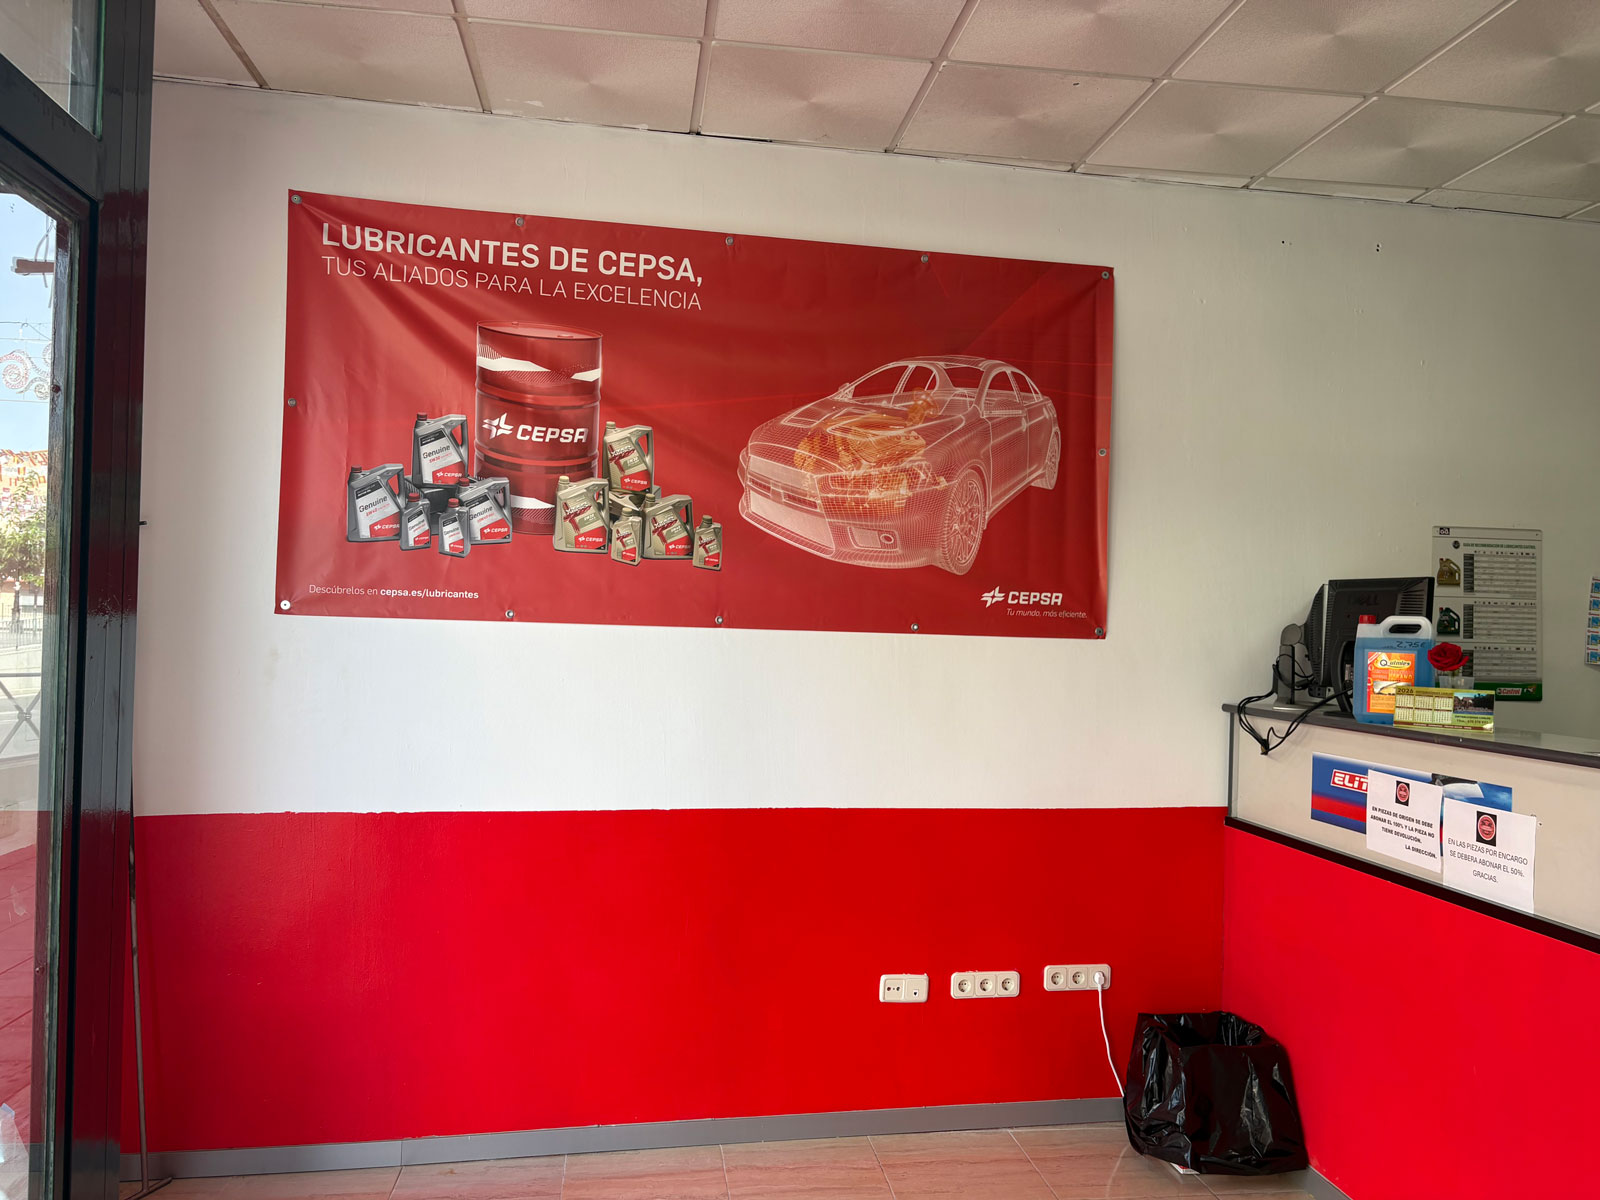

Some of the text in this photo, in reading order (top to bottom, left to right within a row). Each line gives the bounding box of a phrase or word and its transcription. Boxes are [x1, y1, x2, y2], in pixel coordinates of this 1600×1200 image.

[322, 222, 703, 287] LUBRICANTES DE CEPSA,
[321, 254, 702, 311] TUS ALIADOS PARA LA EXCELENCIA
[516, 425, 588, 443] CEPSA
[423, 444, 451, 460] Genuine
[358, 495, 389, 514] Genuine
[468, 505, 494, 522] Genuine
[308, 584, 365, 596] Descúbrelos
[380, 588, 480, 600] cepsa.es/lubricantes
[1007, 591, 1064, 606] CEPSA
[1006, 608, 1016, 616] Tu
[1058, 610, 1089, 619] eficiente.
[1378, 808, 1392, 816] PIEZAS
[1398, 814, 1414, 822] ORIGEN
[1370, 814, 1386, 824] ABONAR
[1393, 821, 1404, 829] 100%
[1414, 828, 1427, 836] PIEZA
[1382, 826, 1394, 834] TIENE
[1448, 838, 1528, 866] EN LAS PIEZAS POR ENCARGO
[1450, 850, 1456, 858] SE
[1457, 852, 1478, 864] DEBERA
[1478, 858, 1502, 871] ABONAR
[1502, 865, 1510, 874] EL
[1472, 870, 1498, 883] GRACIAS.
